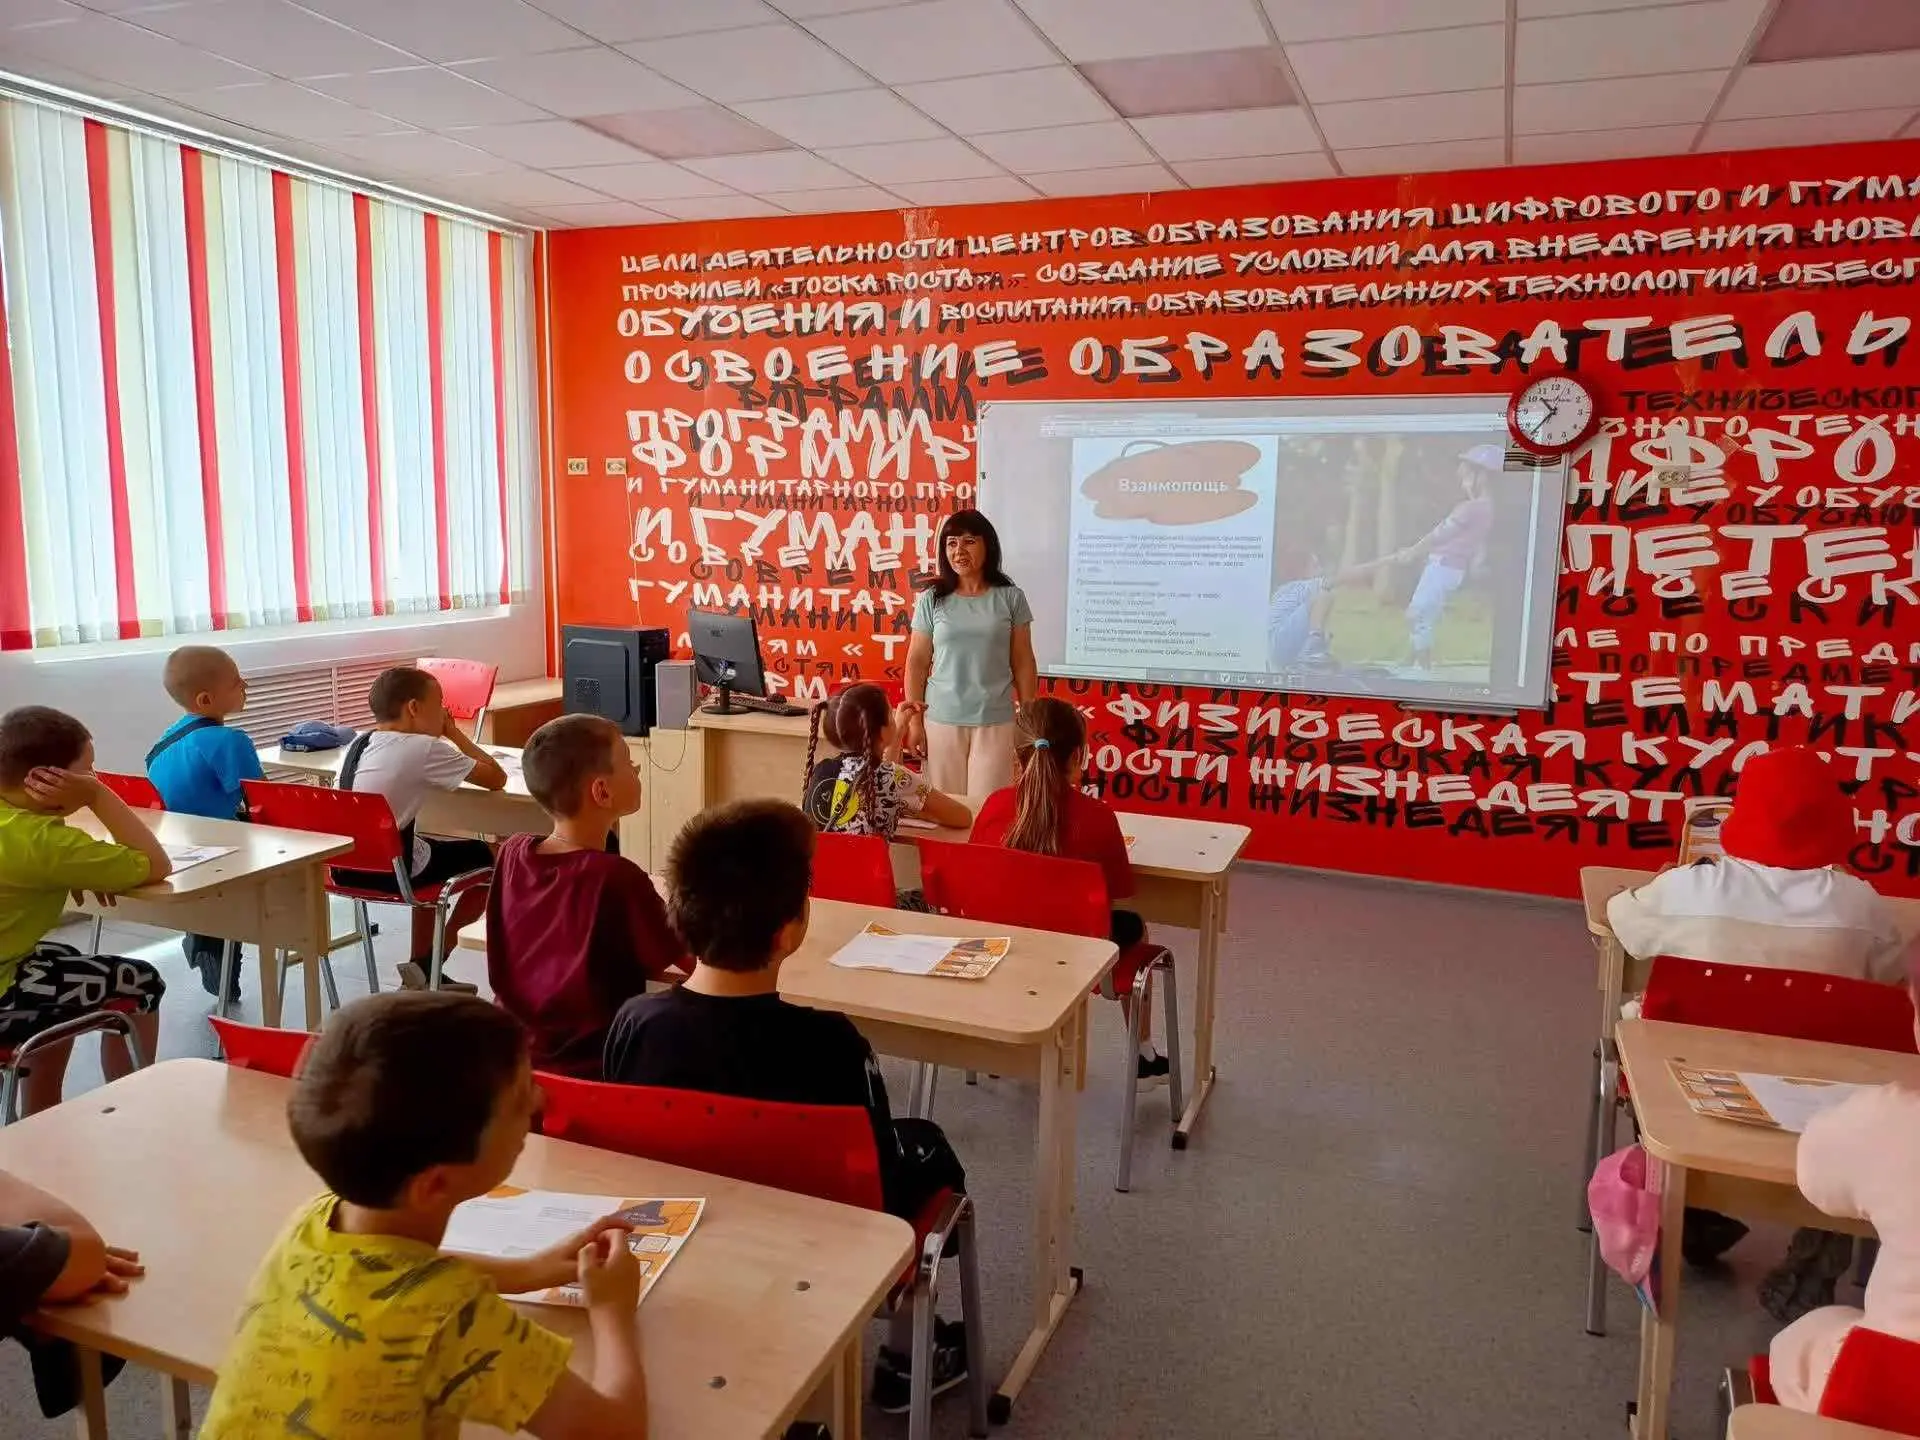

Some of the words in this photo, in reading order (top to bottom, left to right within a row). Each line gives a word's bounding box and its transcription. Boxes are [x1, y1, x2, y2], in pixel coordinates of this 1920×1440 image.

[621, 253, 698, 274] ЦЕЛИ
[706, 238, 955, 272] ДЕЯТЕЛЬНОСТИ
[967, 228, 1136, 256] ЦЕНТРОВ
[1148, 207, 1435, 243] ОБРАЗОВАНИЯ
[1451, 187, 1721, 225] ЦИФРОВОГО
[1739, 184, 1770, 207] И
[622, 276, 762, 301] ПРОФИЛЕЙ
[1036, 253, 1222, 283] СОЗДАНИЕ
[1229, 241, 1401, 274] УСЛОВИЙ
[1409, 240, 1495, 265] ДЛЯ
[1507, 223, 1794, 259] ВНЕДРЕНИЯ
[617, 301, 885, 337] ОБУЧЕНИЯ
[901, 297, 931, 330] И
[1146, 277, 1491, 312] ОБРАЗОВАТЕЛЬНЫХ
[624, 340, 1024, 384] ОСВОЕНИЕ
[1069, 310, 1912, 376] ОБРАЗОВАТЕЛЬ
[626, 407, 934, 443] ПРОГРАММ
[632, 435, 972, 480] ФОРМИР
[628, 477, 642, 494] И
[660, 478, 905, 500] ГУМАНИТАРНОГО
[917, 481, 978, 500] ПРО
[1747, 486, 1784, 507] У
[635, 507, 673, 546] И
[689, 507, 952, 557] ГУМАН
[1558, 524, 1920, 578] ПЕТЕ
[1649, 632, 1708, 653] ПО
[1552, 672, 1920, 724] ТЕМАТИ
